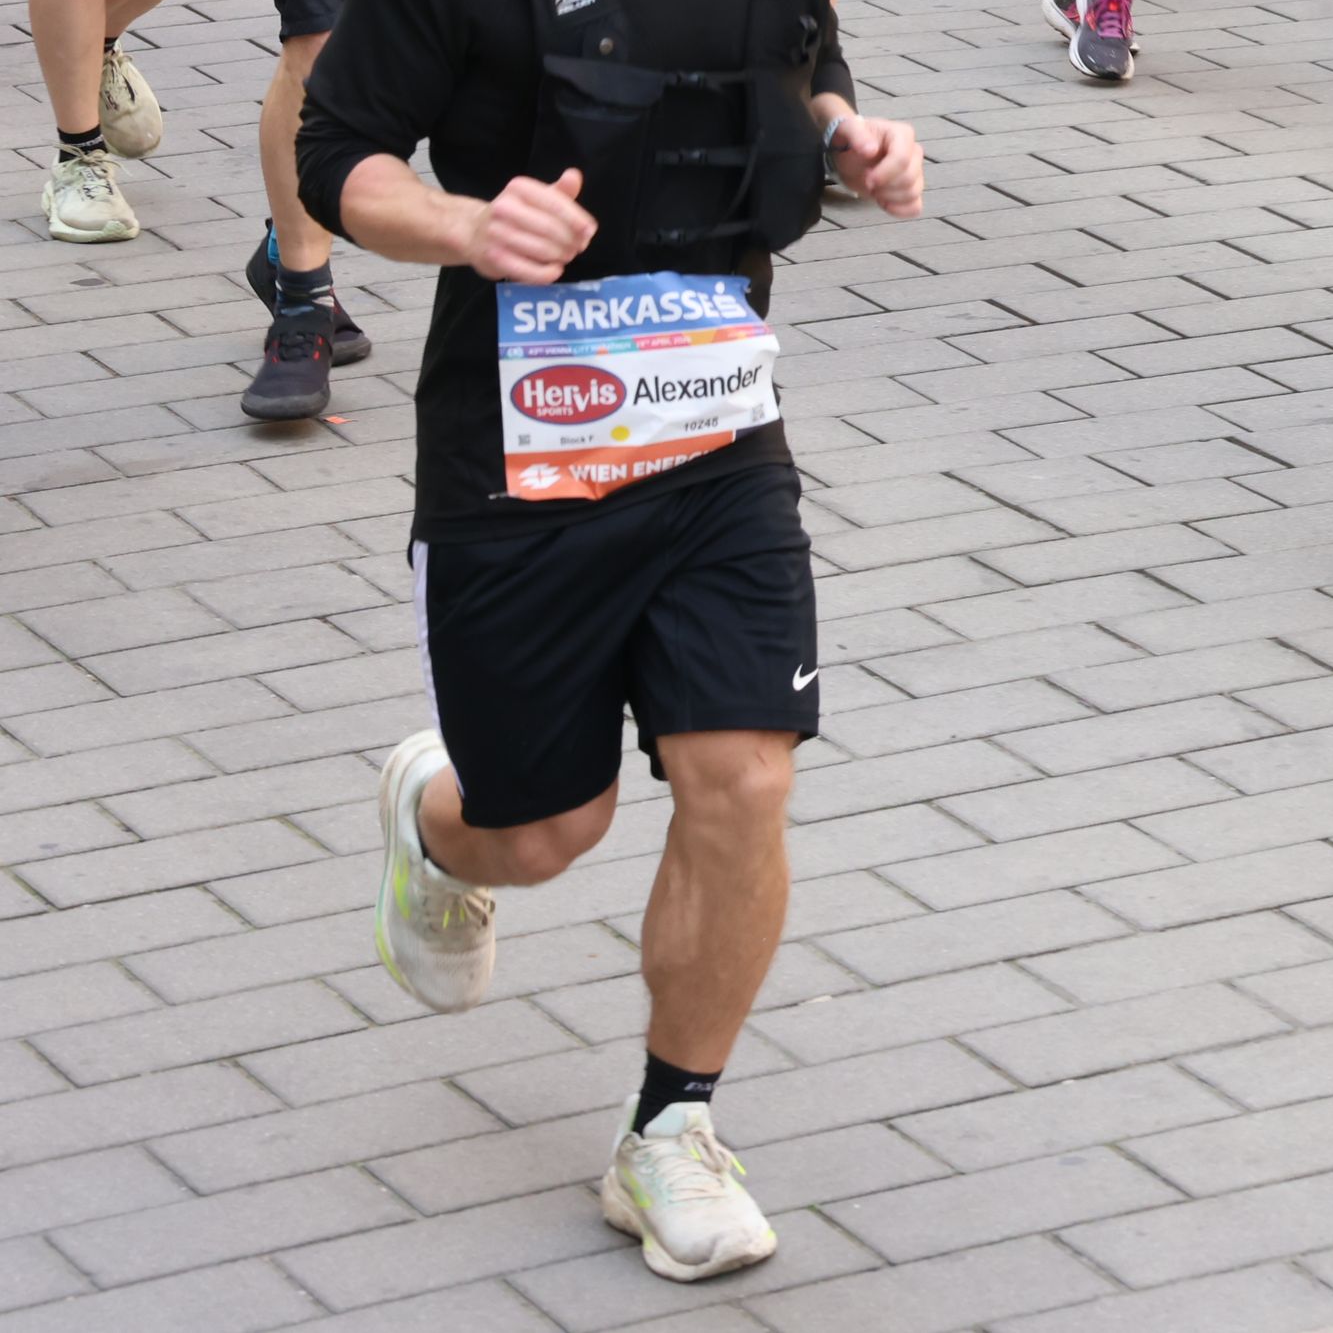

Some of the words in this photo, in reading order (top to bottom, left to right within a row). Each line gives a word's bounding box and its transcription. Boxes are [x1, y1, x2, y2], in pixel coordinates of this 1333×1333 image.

[513, 290, 716, 334] SPARKASSE
[523, 378, 618, 413] Hervis
[633, 364, 763, 406] Alexander
[536, 406, 574, 418] SPORTS
[560, 435, 586, 445] Block
[569, 461, 628, 484] WIEN
